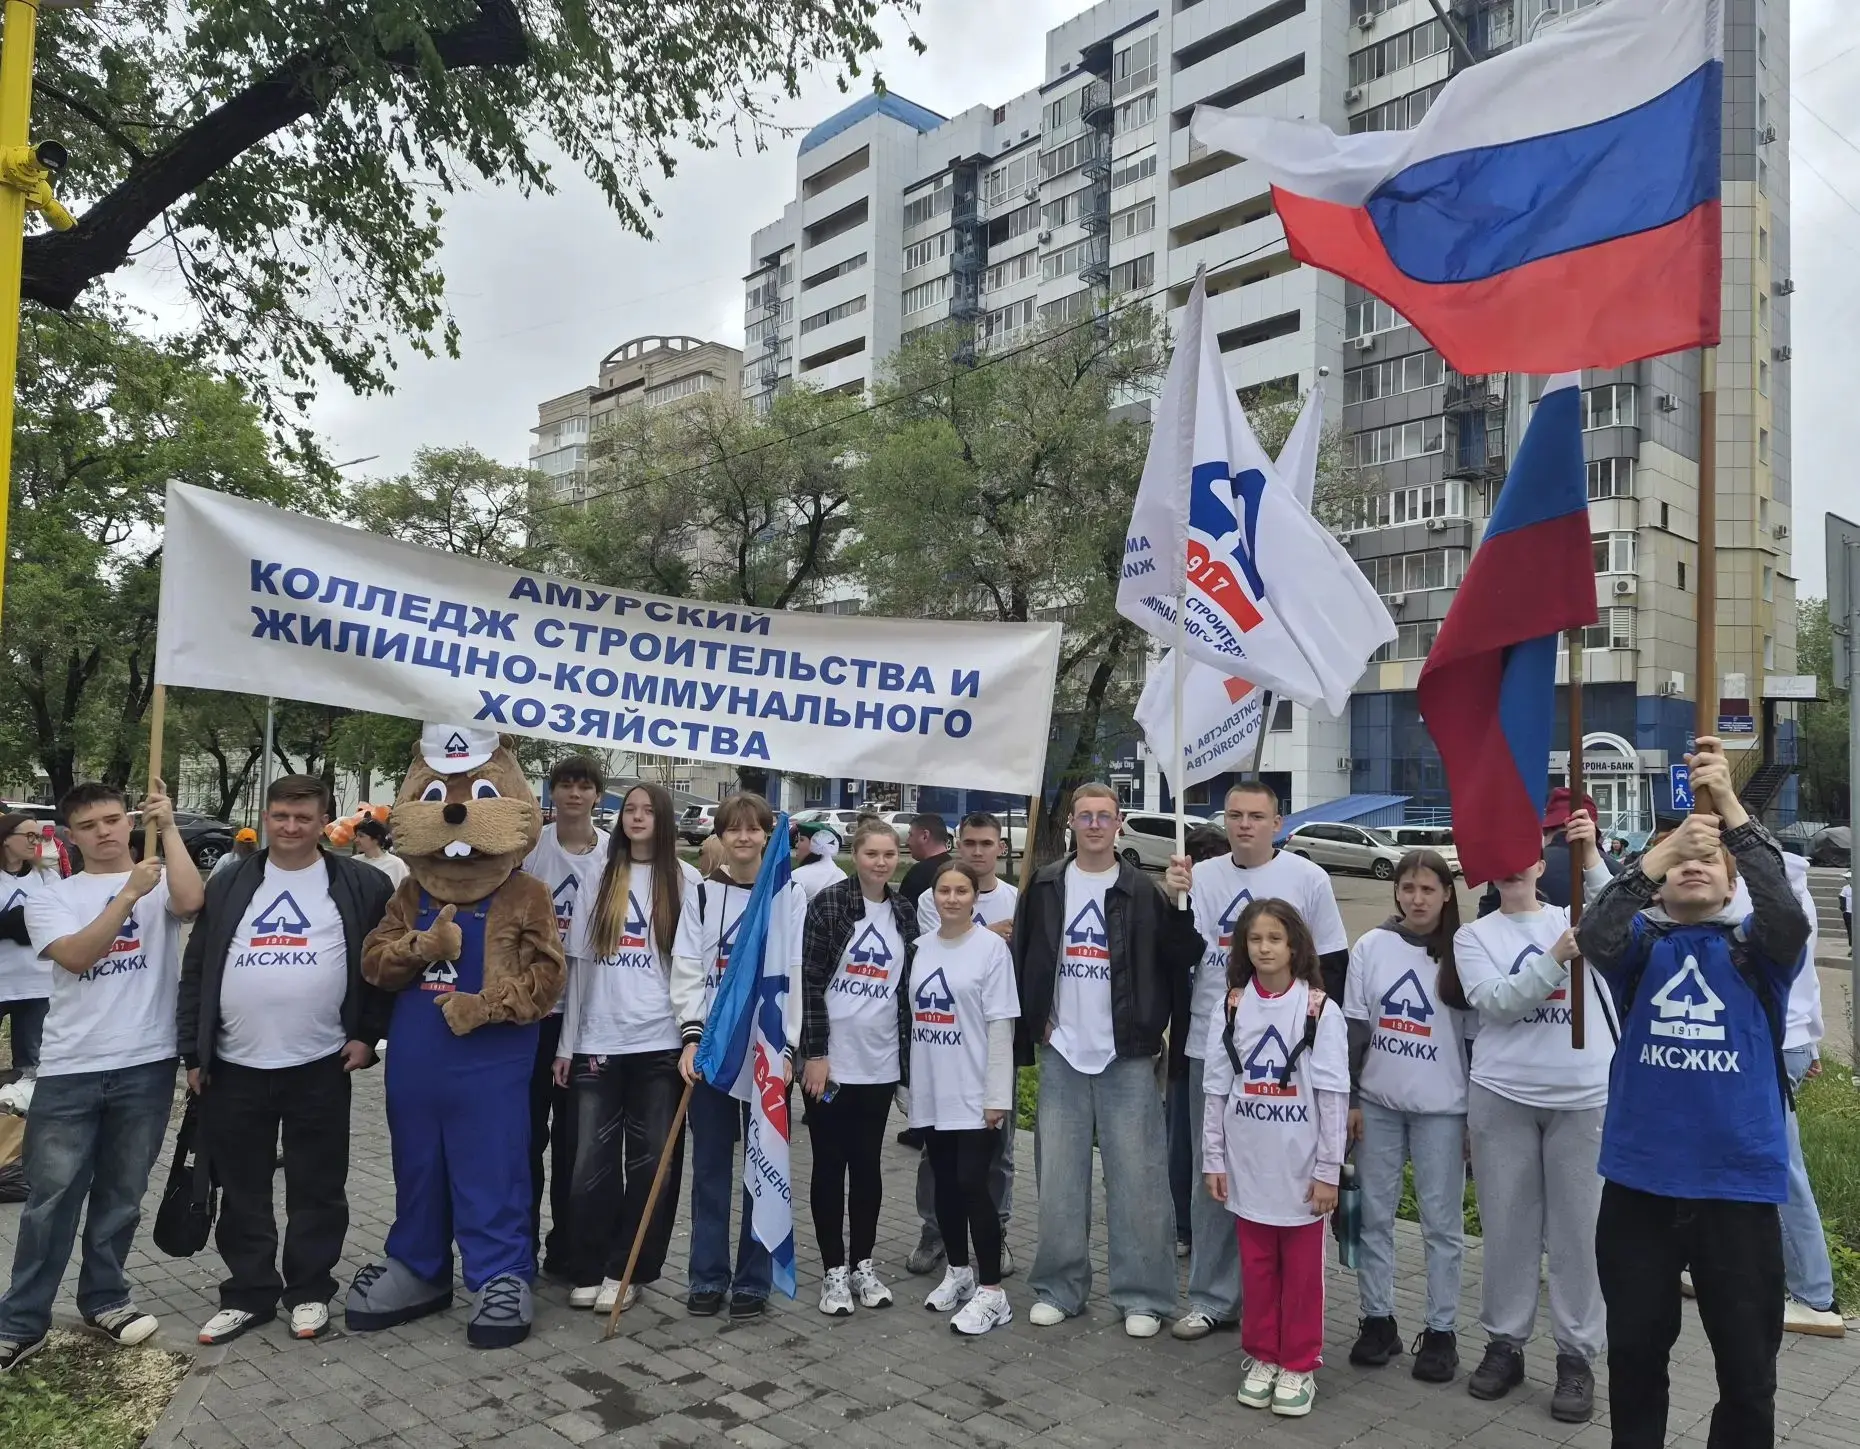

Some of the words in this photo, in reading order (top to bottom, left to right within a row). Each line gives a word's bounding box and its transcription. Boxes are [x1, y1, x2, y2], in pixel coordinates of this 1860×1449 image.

[1187, 555, 1230, 593] 917
[508, 575, 772, 636] АМУРСКИЙ
[250, 558, 519, 642] КОЛЛЕДЖ
[533, 618, 936, 694] СТРОИТЕЛЬСТВА
[950, 669, 980, 698] И
[251, 606, 973, 739] ЖИЛИЩНО-КОММУНАЛЬНОГО
[473, 690, 771, 761] ХОЗЯЙСТВА
[266, 937, 291, 945] 1917
[234, 951, 318, 968] АКСЖКХ
[1078, 948, 1099, 957] 1917
[857, 967, 876, 976] 1917
[1059, 962, 1110, 980] АКСЖК
[830, 977, 889, 999] АКСЖКХ
[925, 1013, 941, 1022] 1917
[1392, 1020, 1415, 1032] 1917
[1671, 1025, 1701, 1037] 1917
[1371, 1033, 1439, 1062] АКСЖКХ
[1640, 1043, 1740, 1073] АКСЖКХ
[1257, 1086, 1281, 1094] 1917
[1235, 1100, 1308, 1122] АКСЖКХ
